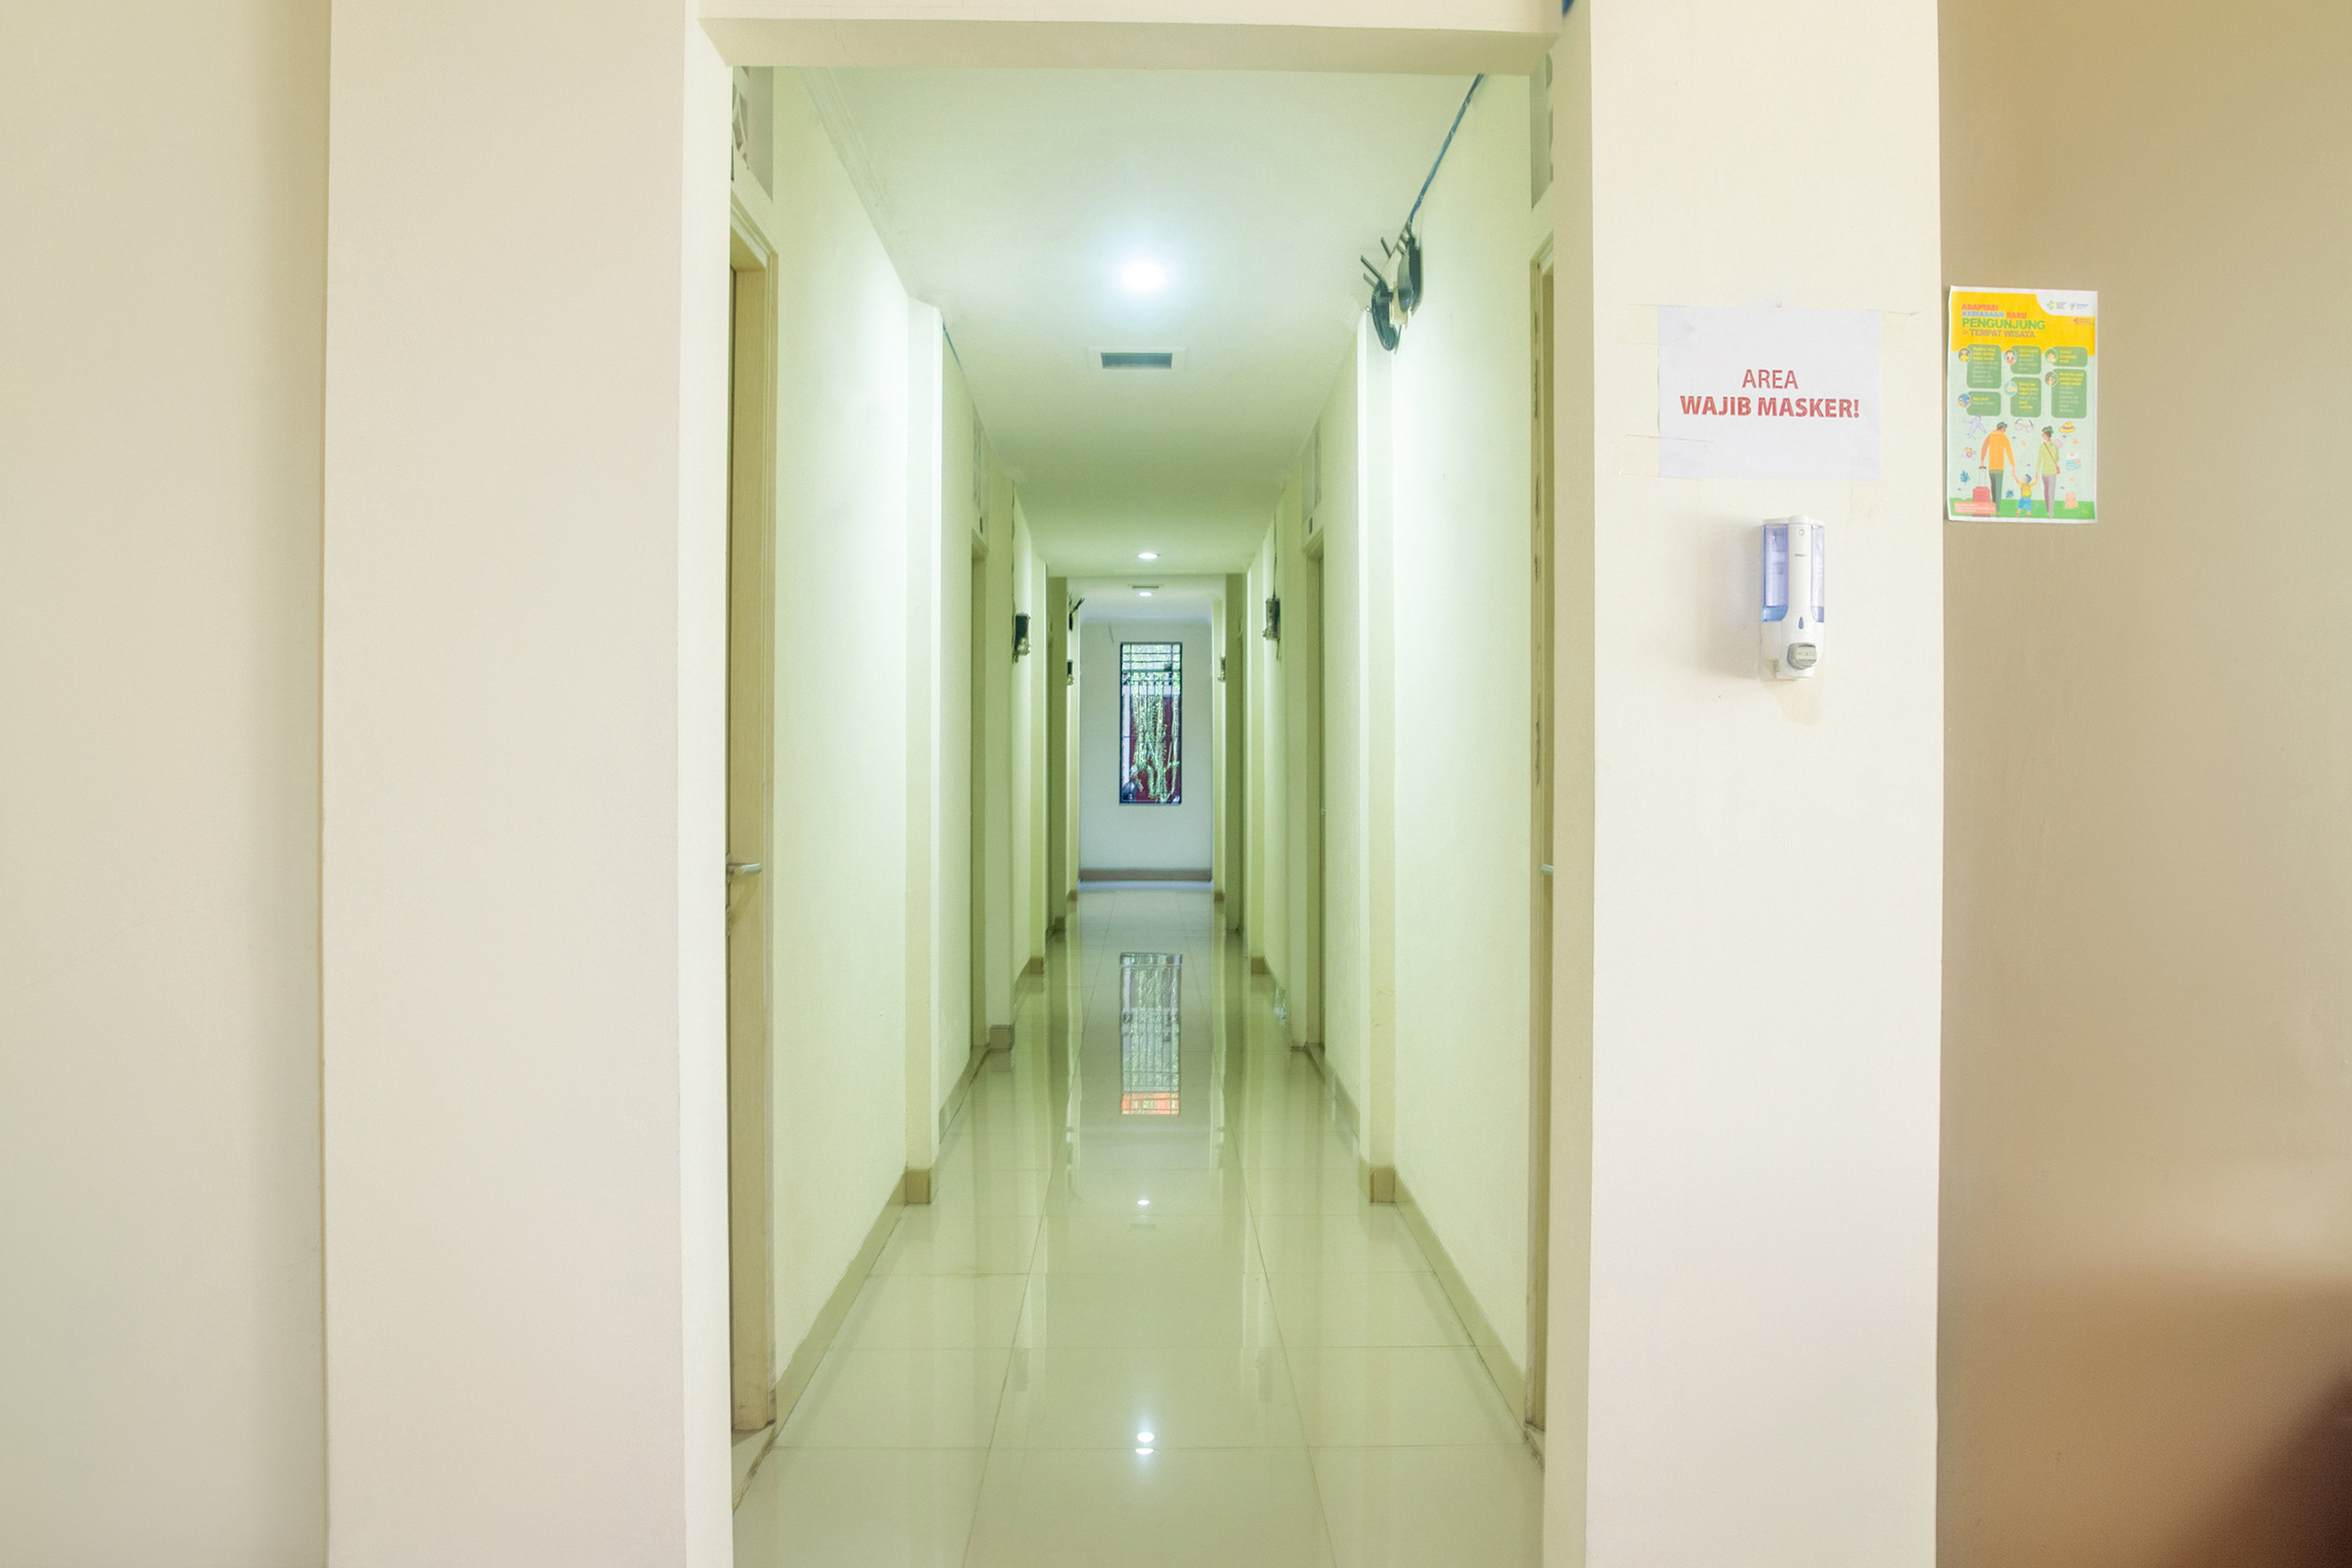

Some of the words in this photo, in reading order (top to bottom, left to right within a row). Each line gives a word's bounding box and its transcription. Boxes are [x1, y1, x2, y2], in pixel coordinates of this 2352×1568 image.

[1962, 318, 2046, 330] PENGUNJUNG
[1969, 328, 2002, 337] TEMPAT
[1742, 368, 1798, 389] AREA
[1680, 395, 1751, 416] WAJIB
[1758, 397, 1860, 418] MASKER!
